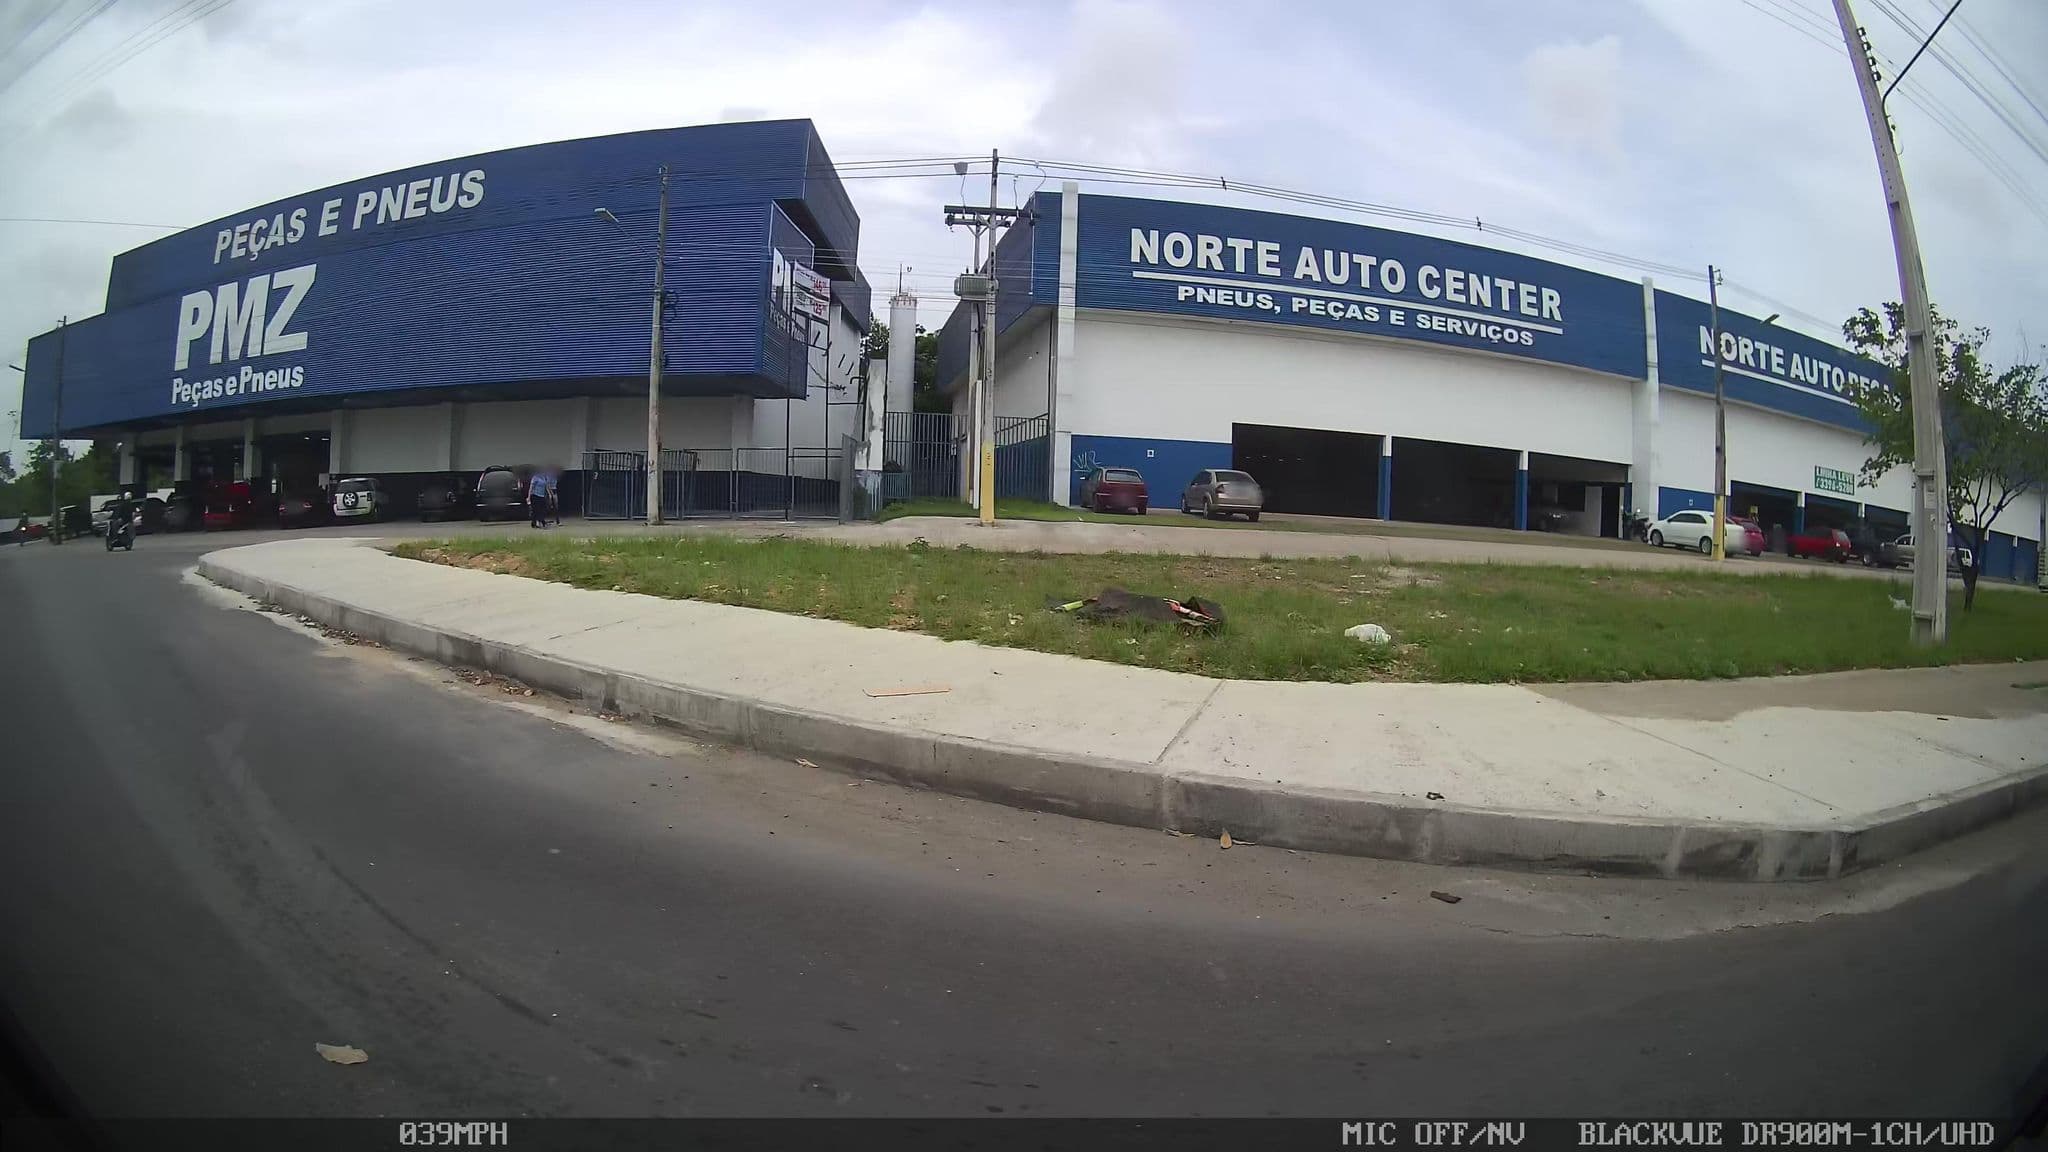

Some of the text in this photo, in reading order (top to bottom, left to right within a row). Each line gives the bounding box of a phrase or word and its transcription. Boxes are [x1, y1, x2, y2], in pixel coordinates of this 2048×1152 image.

[213, 169, 486, 264] PEÇAS E PNEUS
[1130, 228, 1563, 322] NORTE AUTO CENTER
[1177, 285, 1534, 346] PNEUS, PEÇAS E SERVIÇOS
[174, 263, 317, 372] PMZ
[171, 365, 305, 408] Peças e Pneus
[1699, 325, 1785, 375] NORTE
[1789, 352, 1846, 394] AUTO
